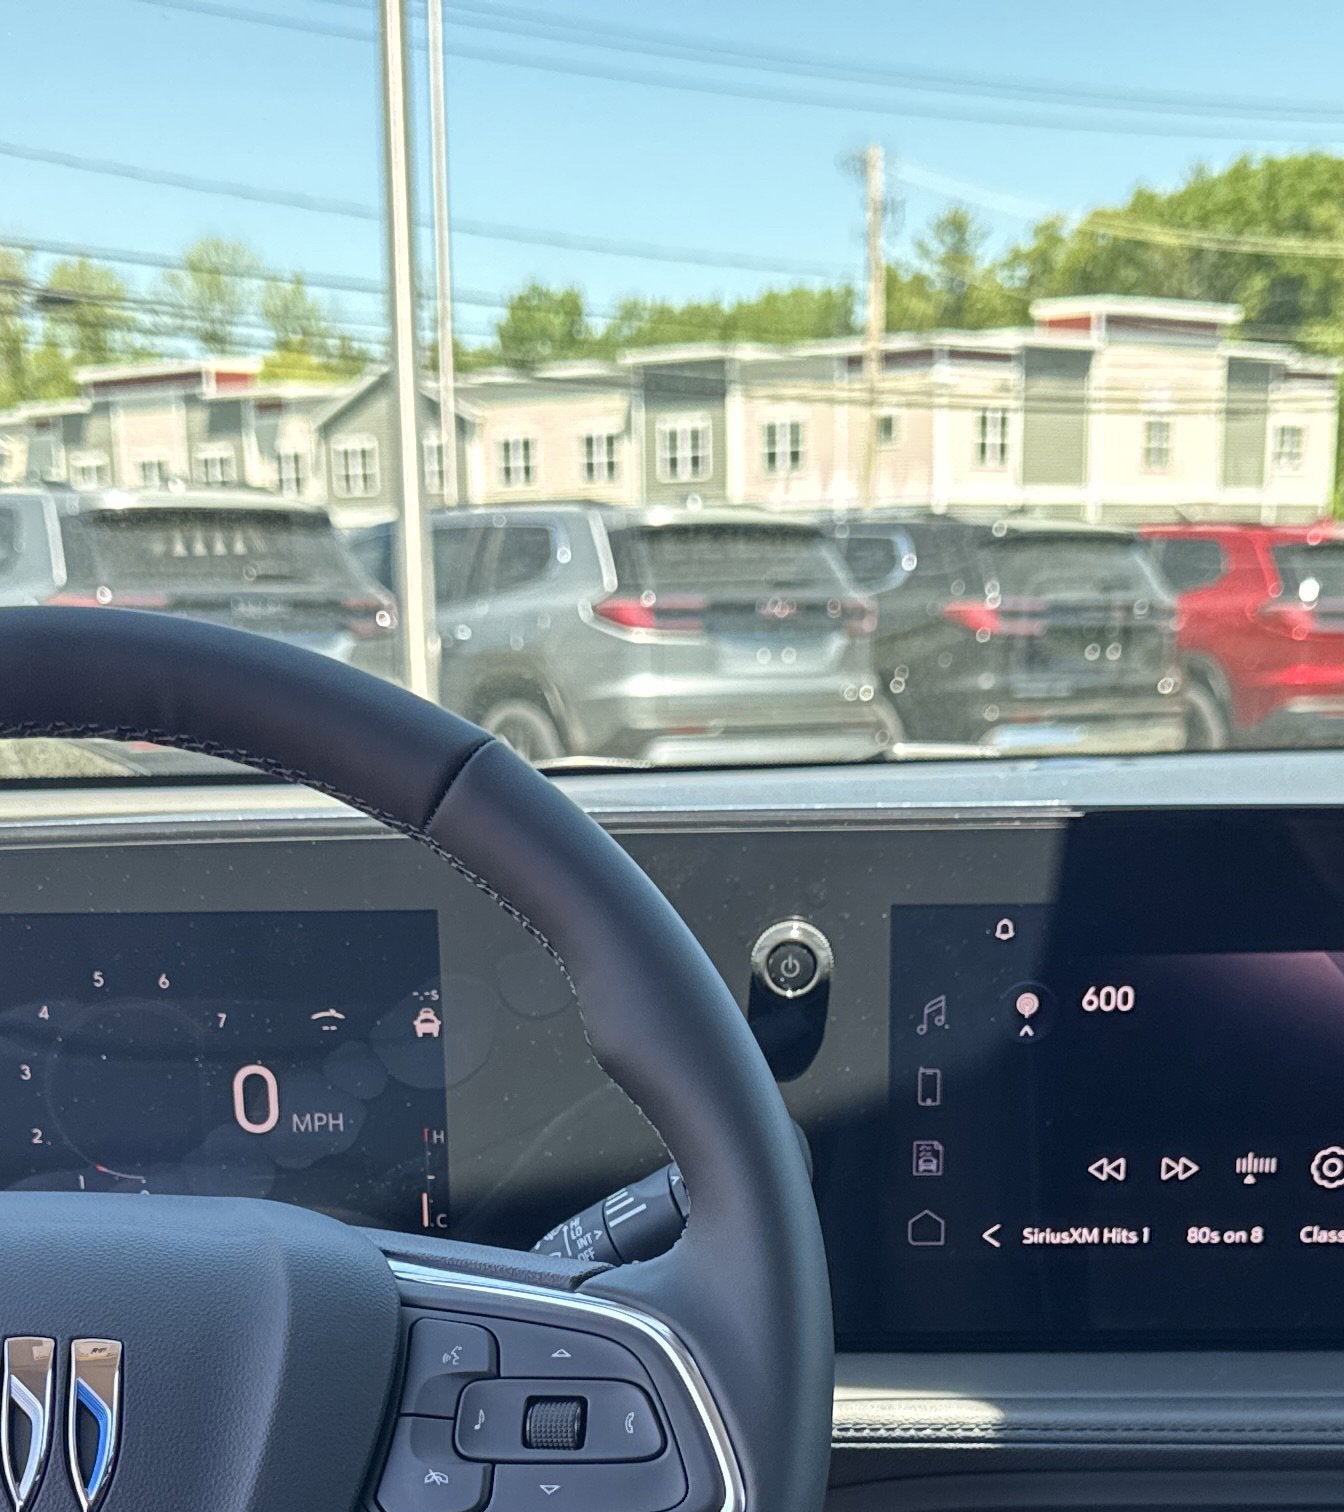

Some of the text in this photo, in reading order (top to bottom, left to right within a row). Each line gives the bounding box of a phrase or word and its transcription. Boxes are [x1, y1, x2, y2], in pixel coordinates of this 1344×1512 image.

[93, 970, 105, 988] 5
[158, 973, 170, 989] 6
[1081, 985, 1135, 1012] 600
[38, 1005, 50, 1021] 4
[216, 1013, 227, 1029] 7
[20, 1064, 32, 1081] 3
[233, 1064, 344, 1134] 0 MPH
[31, 1128, 44, 1144] 2
[432, 1130, 445, 1145] H
[436, 1213, 449, 1229] C
[576, 1232, 592, 1250] INT
[1022, 1227, 1099, 1245] SiriusXM
[1103, 1227, 1139, 1244] Hits
[1187, 1226, 1264, 1244] 80s on 8
